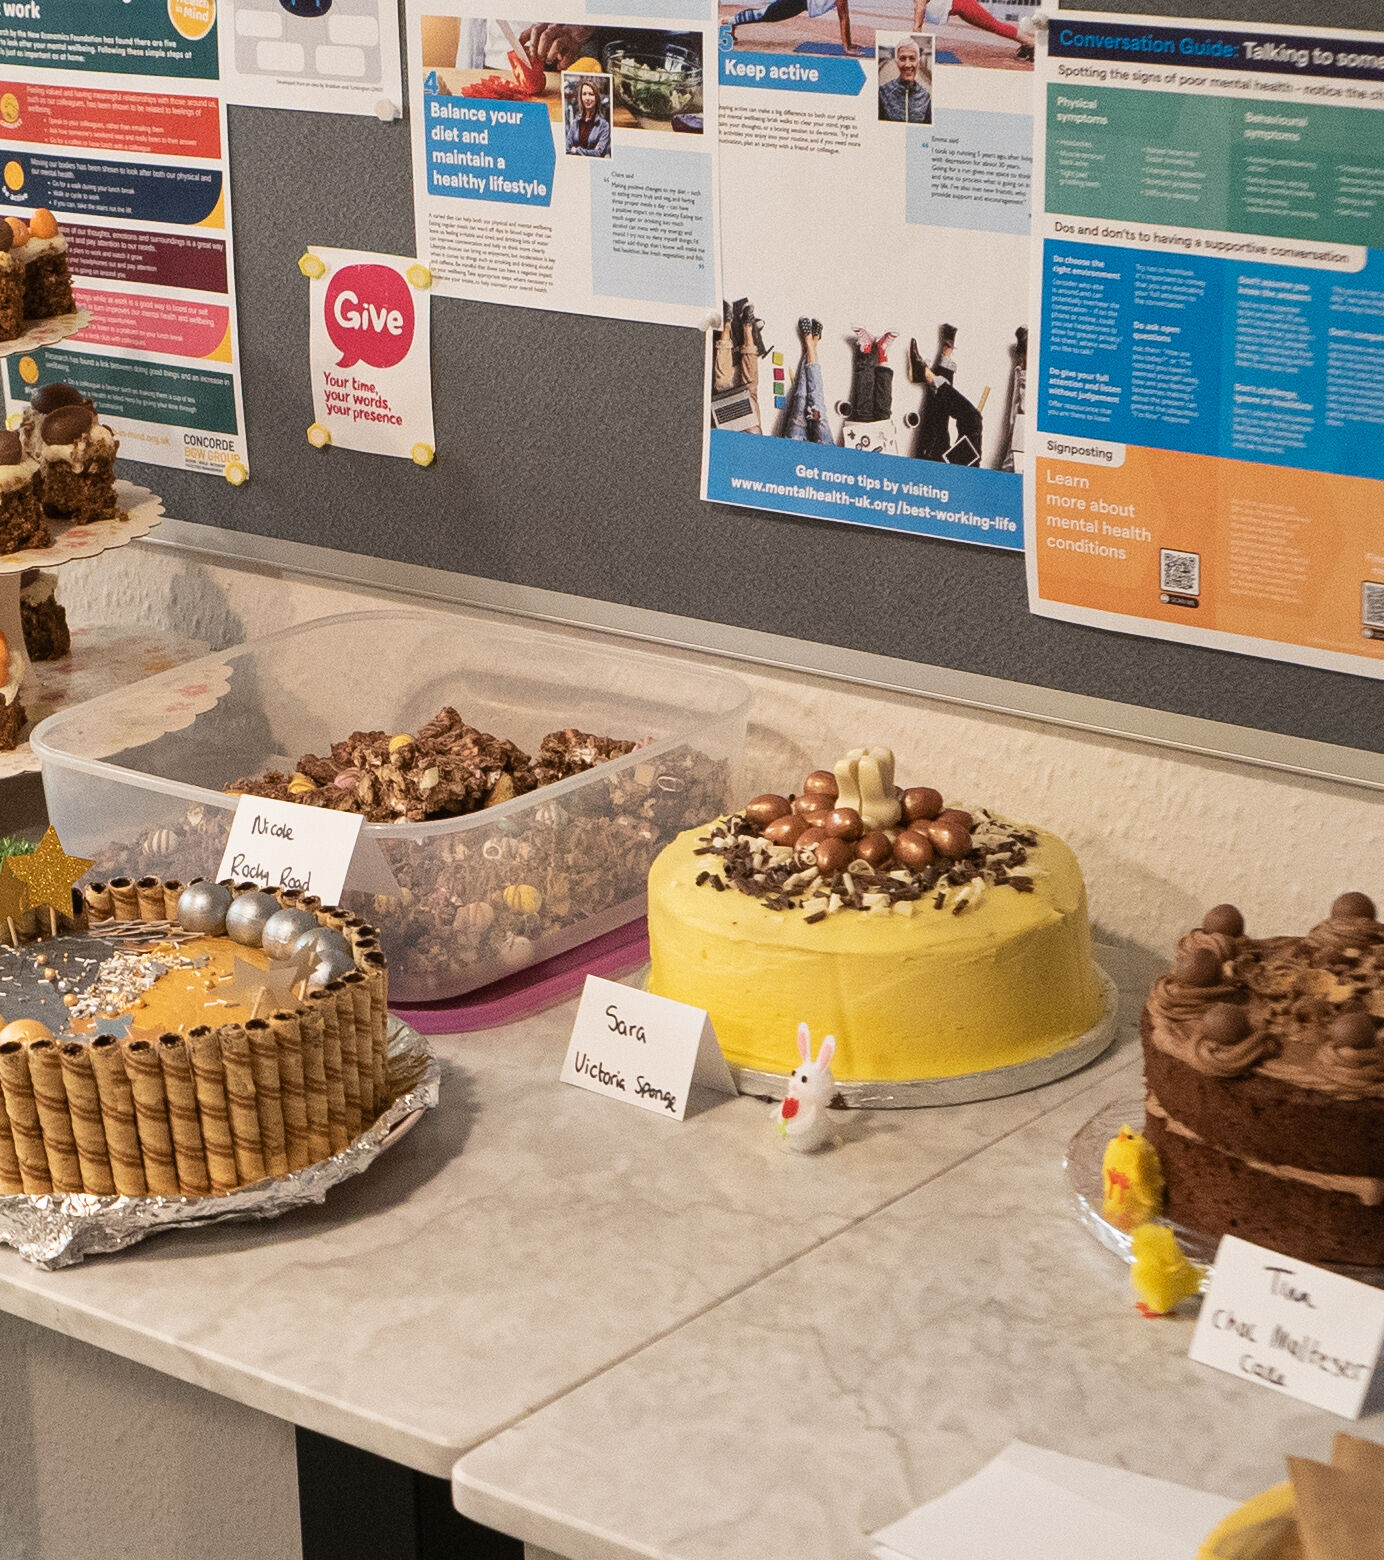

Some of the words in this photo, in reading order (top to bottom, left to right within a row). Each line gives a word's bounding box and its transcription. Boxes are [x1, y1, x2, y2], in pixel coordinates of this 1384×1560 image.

[3, 0, 41, 19] work
[184, 7, 209, 22] Mind
[70, 33, 103, 42] Foundation
[103, 36, 114, 44] has
[115, 36, 133, 45] found
[134, 38, 151, 47] there
[718, 24, 734, 53] 5
[1059, 29, 1175, 53] Conversation
[1179, 37, 1239, 58] Guide:
[1242, 41, 1310, 68] Talking
[1312, 48, 1334, 65] to
[98, 46, 126, 56] Following
[127, 47, 144, 56] these
[145, 48, 165, 58] simple
[724, 58, 766, 81] Keep
[769, 63, 819, 82] active
[1057, 64, 1107, 81] Spotting
[1109, 68, 1129, 80] the
[1132, 69, 1162, 84] signs
[1165, 72, 1177, 83] of
[1179, 75, 1207, 87] poor
[1210, 77, 1251, 90] mental
[1253, 79, 1293, 93] health
[1303, 84, 1342, 98] notice
[423, 70, 439, 95] 4
[430, 101, 487, 121] Balance
[489, 110, 523, 126] your
[1056, 96, 1098, 109] Physical
[1056, 113, 1108, 125] symptoms
[431, 125, 459, 142] diet
[462, 129, 488, 145] and
[1244, 129, 1301, 142] symptoms
[432, 149, 494, 169] maintain
[496, 157, 506, 169] a
[176, 171, 200, 182] physical
[200, 173, 212, 183] and
[433, 169, 486, 194] healthy
[489, 175, 547, 198] lifestyle
[1054, 221, 1075, 235] Dos
[1078, 226, 1098, 237] and
[1102, 228, 1135, 242] don'ts
[1138, 232, 1151, 242] to
[1154, 233, 1192, 249] having
[1195, 239, 1202, 247] a
[1205, 240, 1266, 256] supportive
[1270, 246, 1349, 264] conversation
[1072, 268, 1121, 280] environment
[333, 290, 404, 336] Give
[323, 371, 350, 389] Your
[352, 376, 379, 395] time,
[1077, 372, 1095, 380] your
[324, 389, 350, 403] your
[353, 393, 392, 411] words,
[326, 402, 351, 417] your
[353, 408, 403, 426] presence
[183, 433, 235, 452] CONCORDE
[1047, 440, 1112, 461] Signposting
[207, 450, 241, 463] GROUP
[795, 464, 819, 482] Get
[822, 471, 855, 487] more
[857, 473, 881, 492] tips
[883, 477, 899, 495] by
[901, 480, 949, 502] visiting
[1046, 469, 1089, 489] Learn
[731, 477, 1017, 533] www.mentalhealth-uk.org/best-working-life
[1046, 495, 1086, 510] more
[1090, 497, 1135, 519] about
[1046, 514, 1099, 534] mental
[1103, 522, 1152, 543] health
[1046, 535, 1127, 560] conditions
[251, 815, 295, 840] Nicole
[231, 854, 269, 886] Rocky
[280, 867, 311, 891] Road
[606, 1005, 647, 1044] Sara
[575, 1051, 626, 1091] Victoria
[635, 1076, 676, 1112] Sponge
